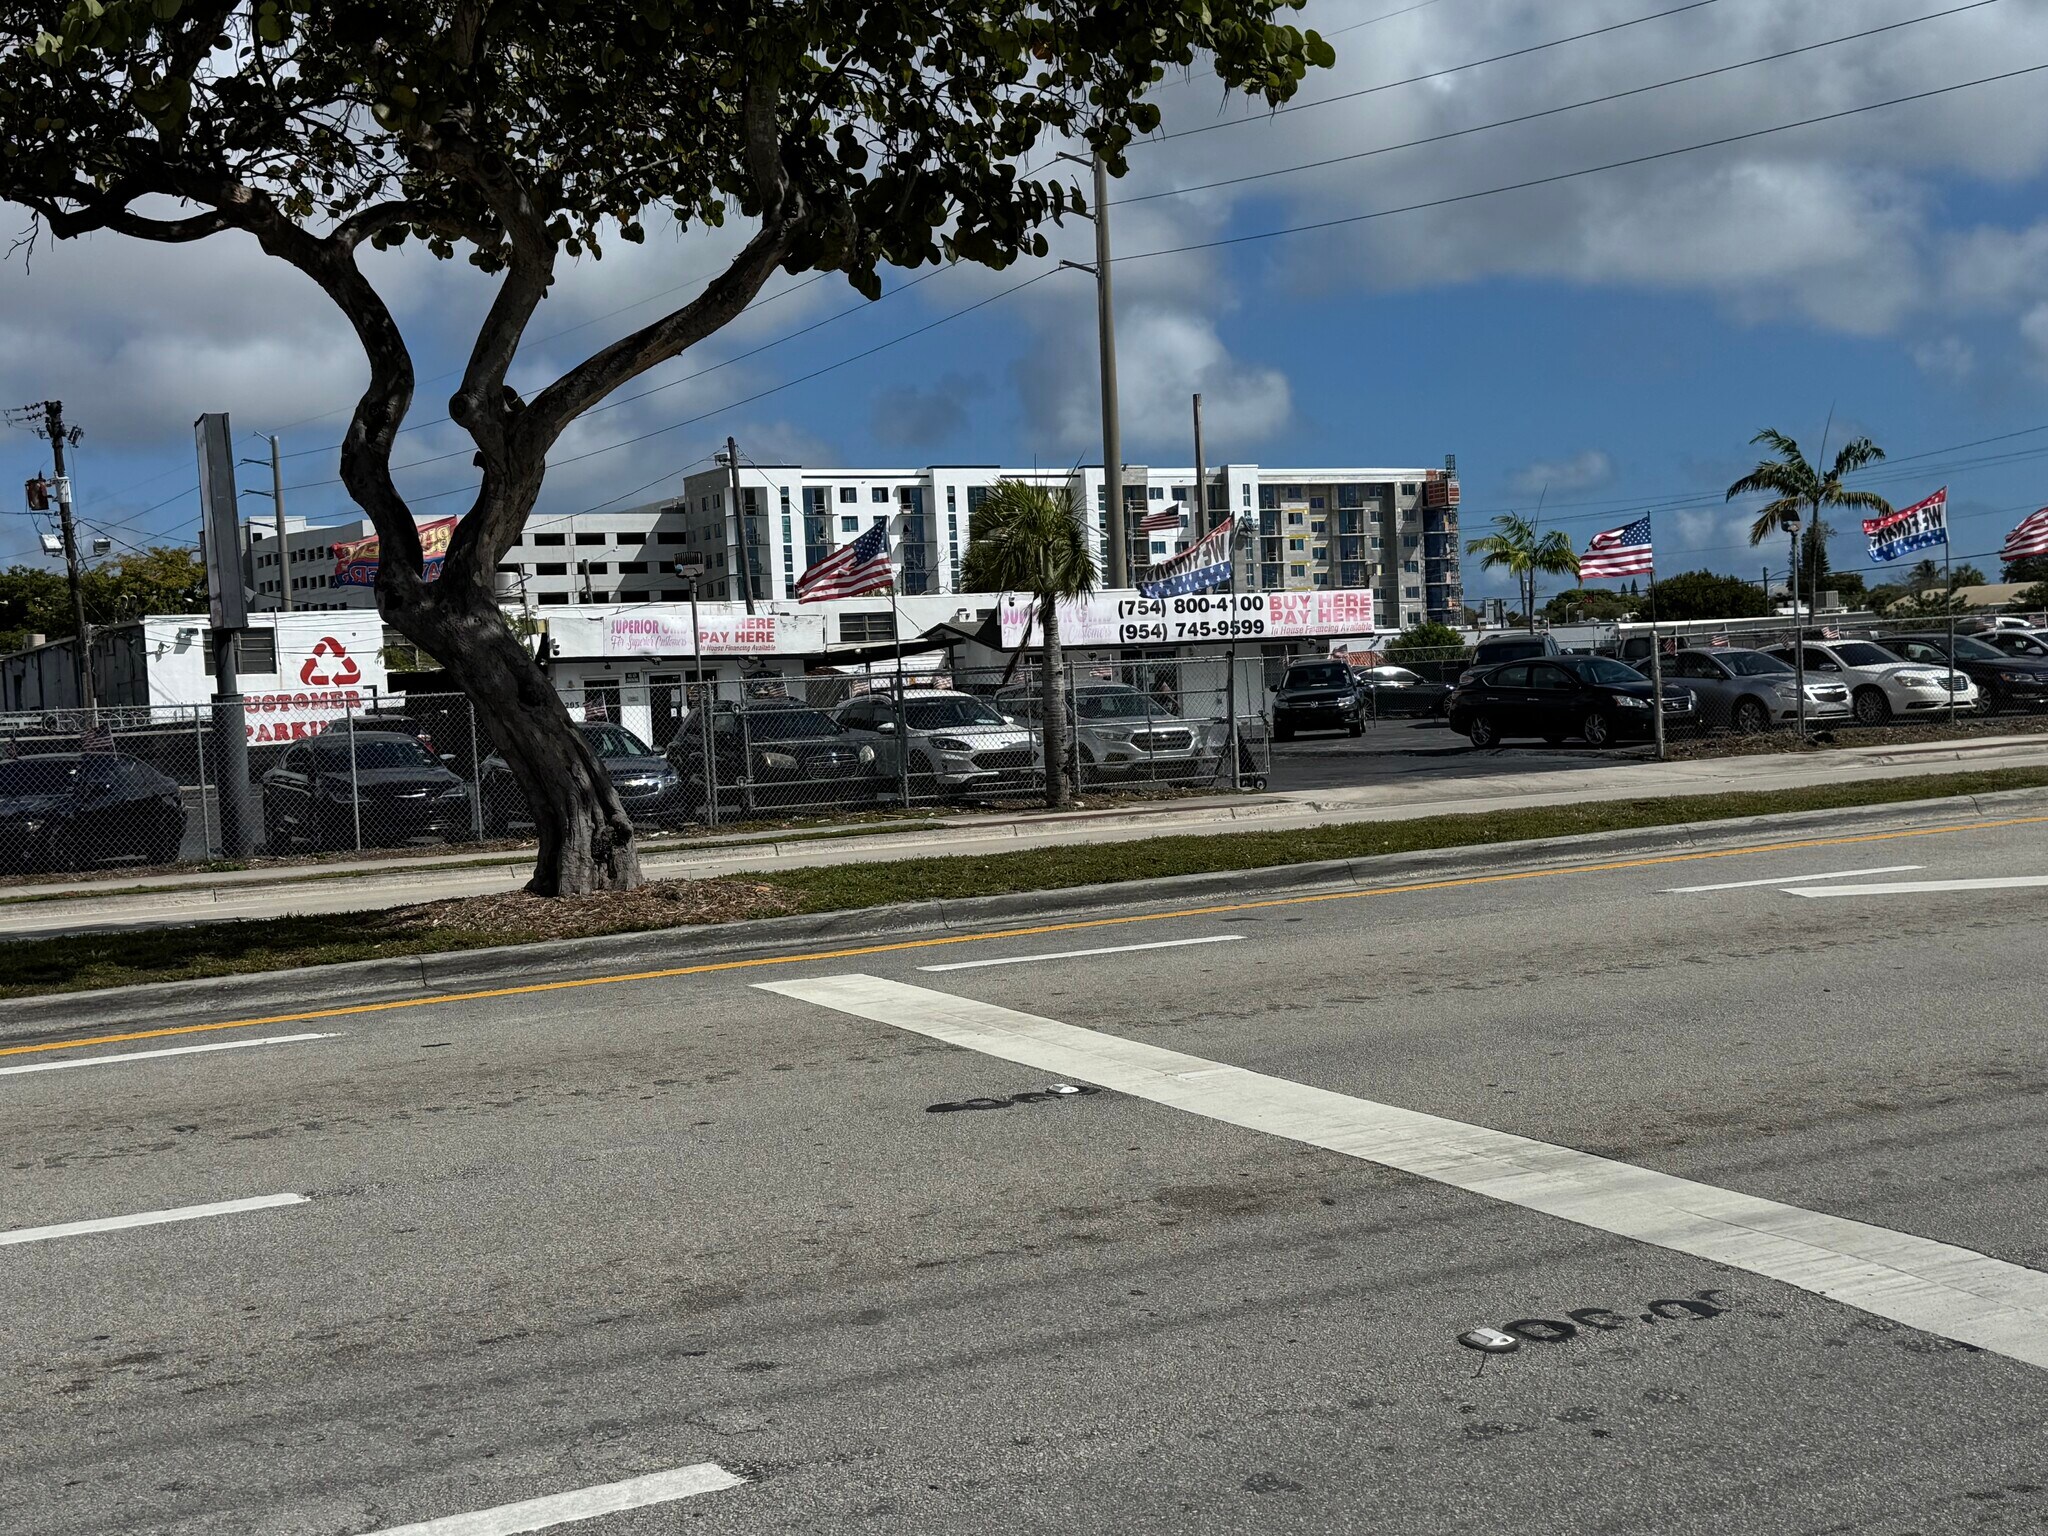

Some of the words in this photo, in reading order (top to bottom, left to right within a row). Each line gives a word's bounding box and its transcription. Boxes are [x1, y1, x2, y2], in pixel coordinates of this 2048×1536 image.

[1118, 599, 1167, 619] (754)
[1174, 595, 1264, 614] 800-4100
[1269, 594, 1311, 611] BUY
[1318, 592, 1372, 608] HERE
[1270, 610, 1311, 625] PAY
[1318, 607, 1372, 623] HERE
[611, 619, 660, 634] SUPERIOR
[1119, 622, 1168, 643] (954)
[1175, 619, 1265, 637] 745-9599
[1280, 624, 1304, 635] House
[1305, 622, 1339, 634] Financing
[1340, 621, 1373, 633] Available
[611, 635, 624, 650] For
[626, 634, 655, 650] Superior
[655, 634, 687, 650] Customers
[699, 631, 730, 643] PAY
[735, 631, 776, 643] HERE
[706, 644, 724, 652] House
[724, 643, 751, 653] Financing
[751, 643, 776, 652] Available
[243, 690, 362, 715] USTOMER
